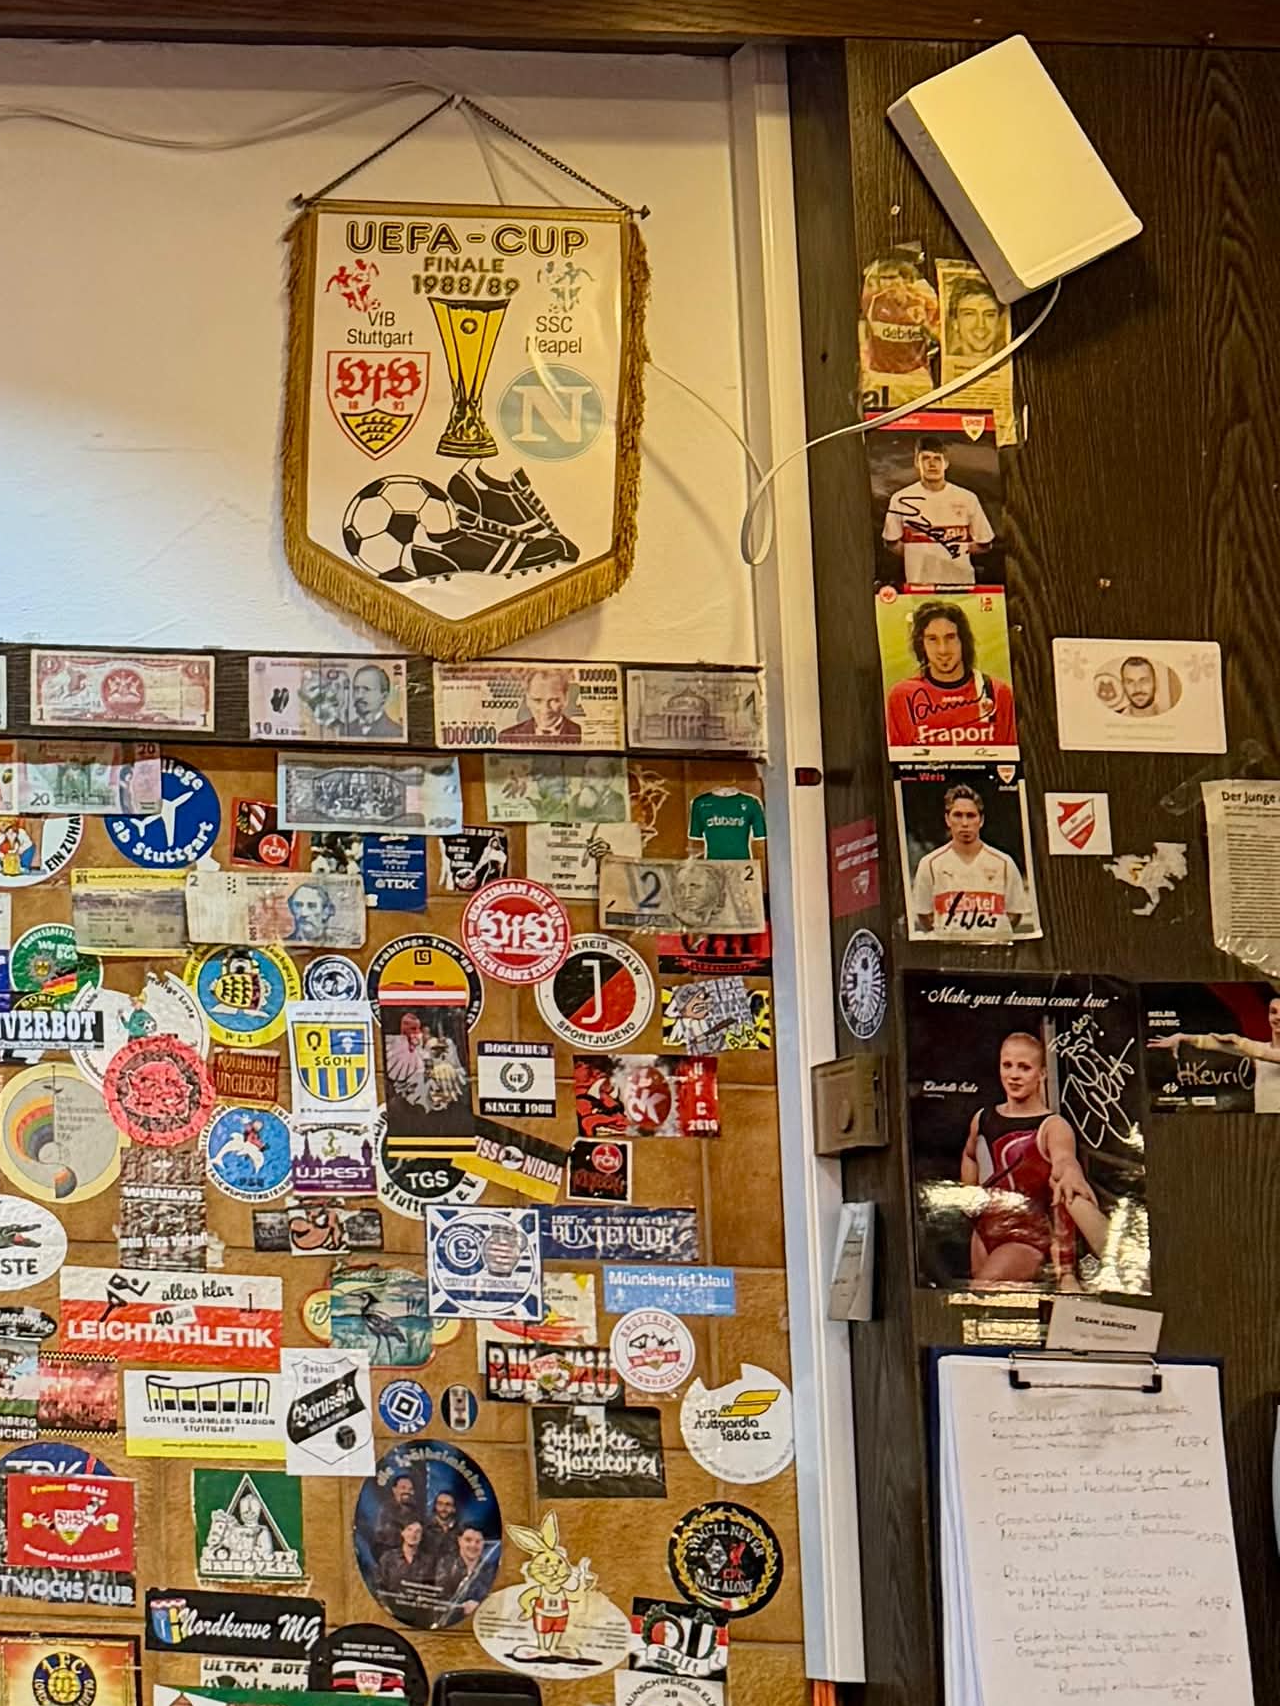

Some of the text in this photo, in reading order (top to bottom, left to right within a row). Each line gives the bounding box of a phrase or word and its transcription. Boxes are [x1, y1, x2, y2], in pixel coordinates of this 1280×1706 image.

[422, 256, 506, 274] FINALE
[412, 275, 521, 297] 1988/89
[366, 309, 397, 328] VfB
[534, 314, 574, 334] SSC
[345, 327, 414, 347] Stuttgart
[917, 724, 996, 745] Fraport
[1221, 790, 1277, 806] Der Junge
[110, 819, 215, 866] ab Stuttgart
[572, 939, 644, 977] KREIS CALW
[969, 990, 1003, 1011] your
[1003, 988, 1047, 1007] dreams
[1048, 994, 1080, 1007] come
[556, 1018, 637, 1045] SPORTJUGEND
[313, 1055, 353, 1067] SGOH
[484, 1102, 522, 1115] SINCE
[295, 1164, 371, 1180] ÚJPEST
[406, 1170, 450, 1188] TGS
[521, 1156, 564, 1185] NIDDA
[607, 1270, 673, 1287] München
[698, 1273, 730, 1288] blau
[160, 1279, 235, 1302] alles klar
[153, 1310, 175, 1327] 40
[66, 1319, 275, 1350] LEICHTATHLETIK
[182, 1425, 237, 1434] STUTTGART
[720, 1429, 750, 1442] 1886
[85, 1484, 110, 1497] ALLE
[730, 1525, 766, 1559] NEVER
[88, 1580, 135, 1605] CLUB
[178, 1605, 323, 1649] Nordkurve MG
